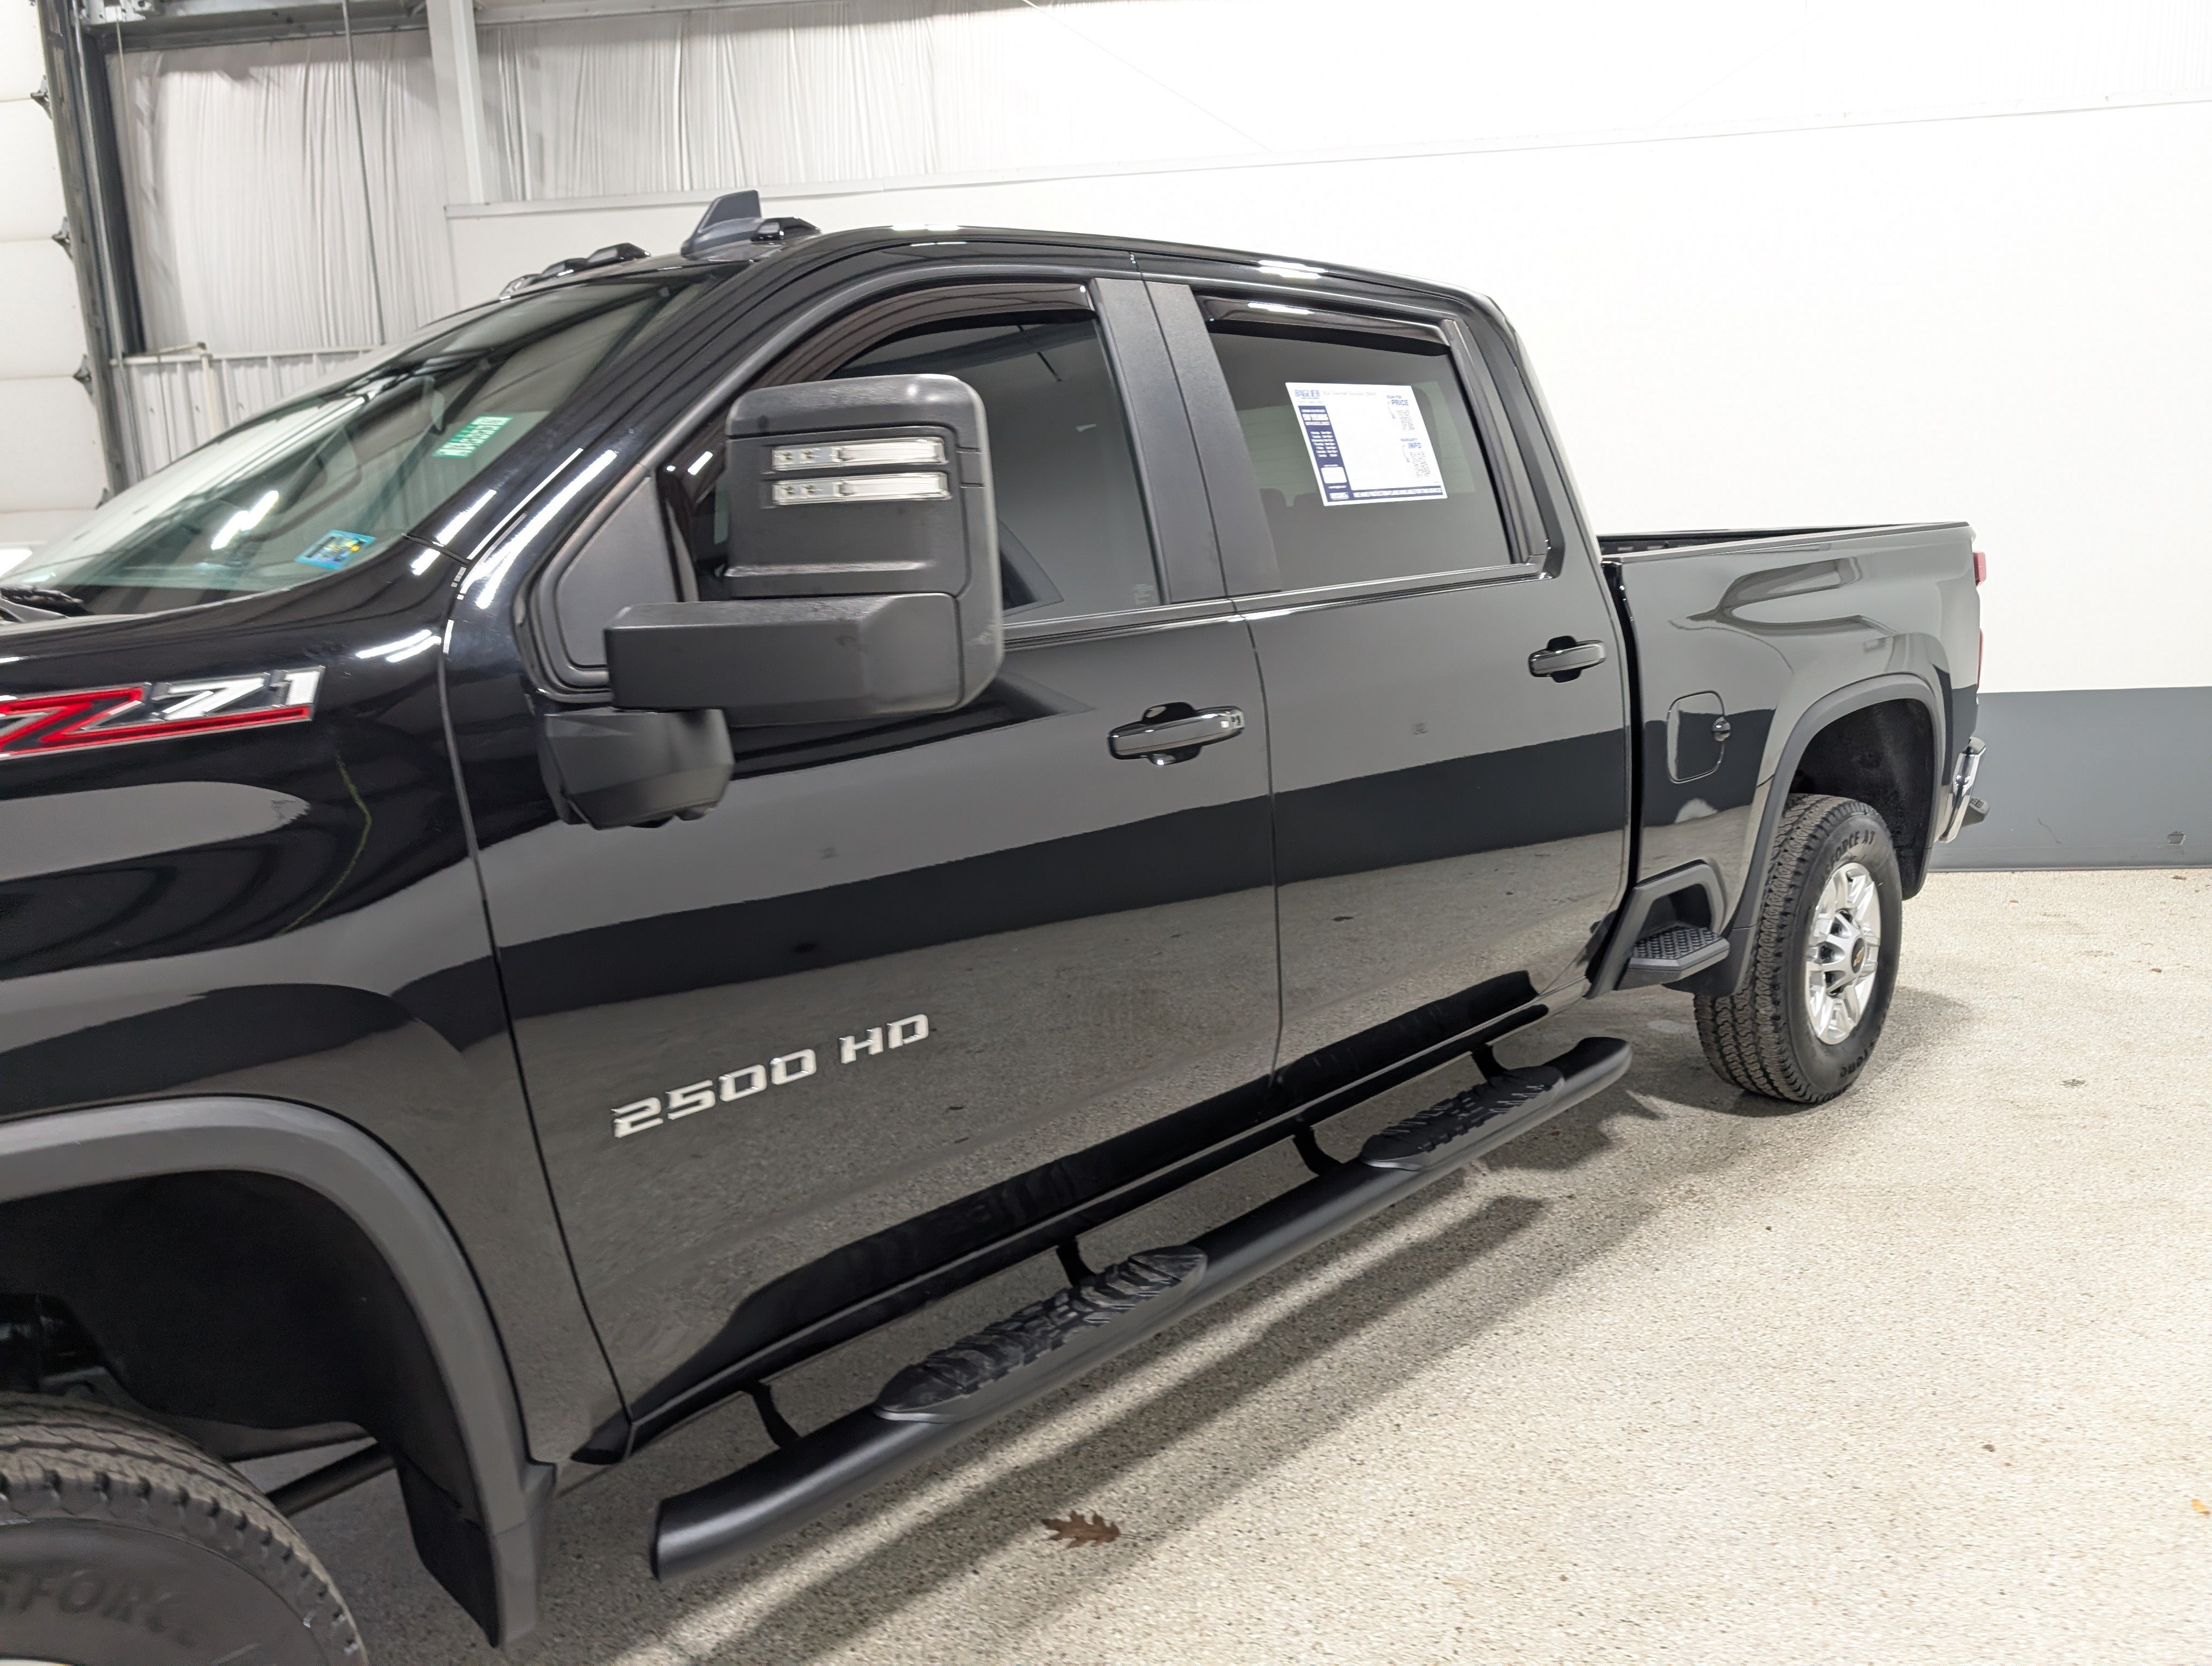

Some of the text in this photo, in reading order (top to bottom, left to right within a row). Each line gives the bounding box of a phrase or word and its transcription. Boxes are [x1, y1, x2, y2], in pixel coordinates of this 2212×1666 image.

[1861, 829, 1877, 845] AT
[610, 1013, 929, 1138] 2500 HD
